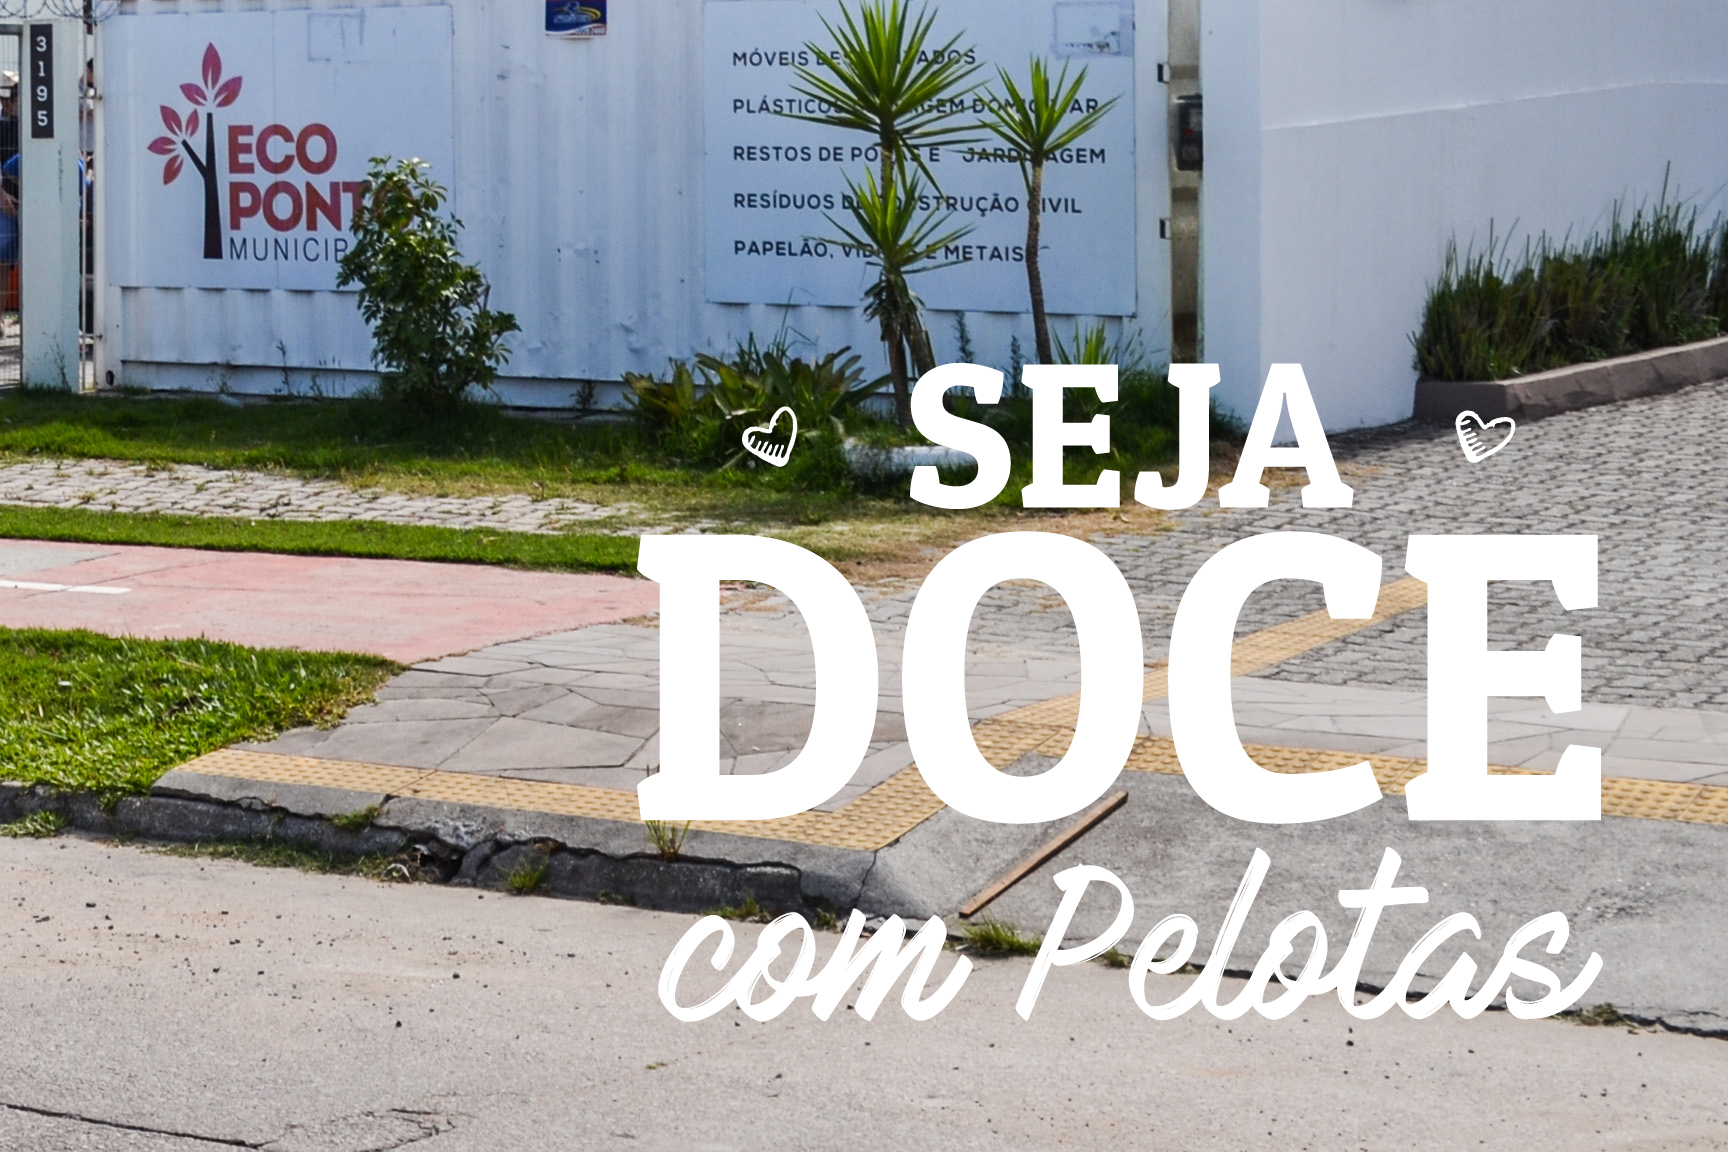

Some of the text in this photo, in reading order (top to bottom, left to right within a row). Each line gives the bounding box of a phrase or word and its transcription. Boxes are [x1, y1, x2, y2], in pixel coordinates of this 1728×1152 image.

[733, 48, 809, 67] MÓVEIS
[36, 36, 48, 127] 3195
[228, 123, 338, 175] ECO
[733, 146, 812, 162] RESTOS
[819, 146, 844, 162] DE
[929, 147, 940, 162] E
[962, 147, 1105, 164] JARDIAGEM
[229, 181, 374, 232] PONT
[733, 190, 835, 210] RESÍDUOS
[1027, 197, 1083, 214] IVIL
[229, 237, 350, 262] MUNICIP
[734, 239, 834, 259] PAPELÃO,
[944, 245, 1024, 262] METAIS
